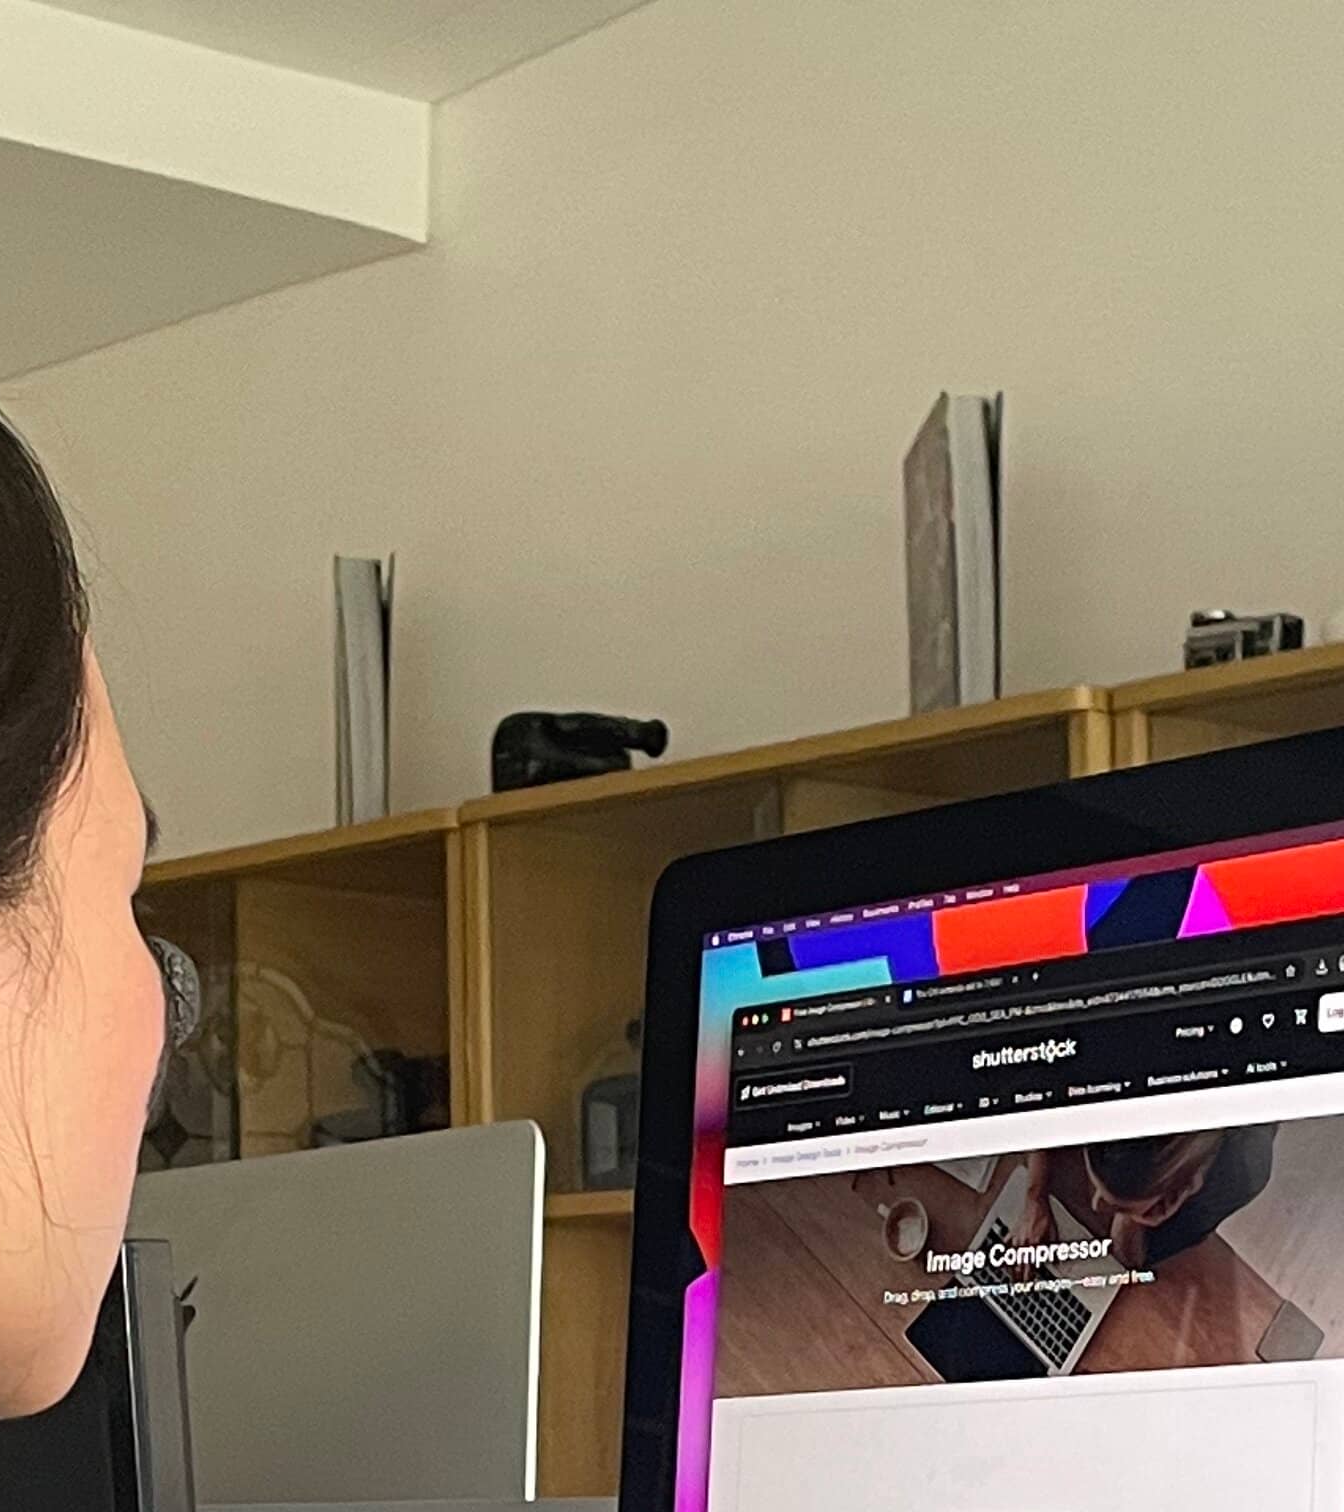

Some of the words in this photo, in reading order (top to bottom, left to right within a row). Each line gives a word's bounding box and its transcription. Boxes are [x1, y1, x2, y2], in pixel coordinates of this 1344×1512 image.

[972, 1037, 1076, 1070] shutterstock
[926, 1249, 985, 1275] Image
[989, 1238, 1113, 1268] Compressor
